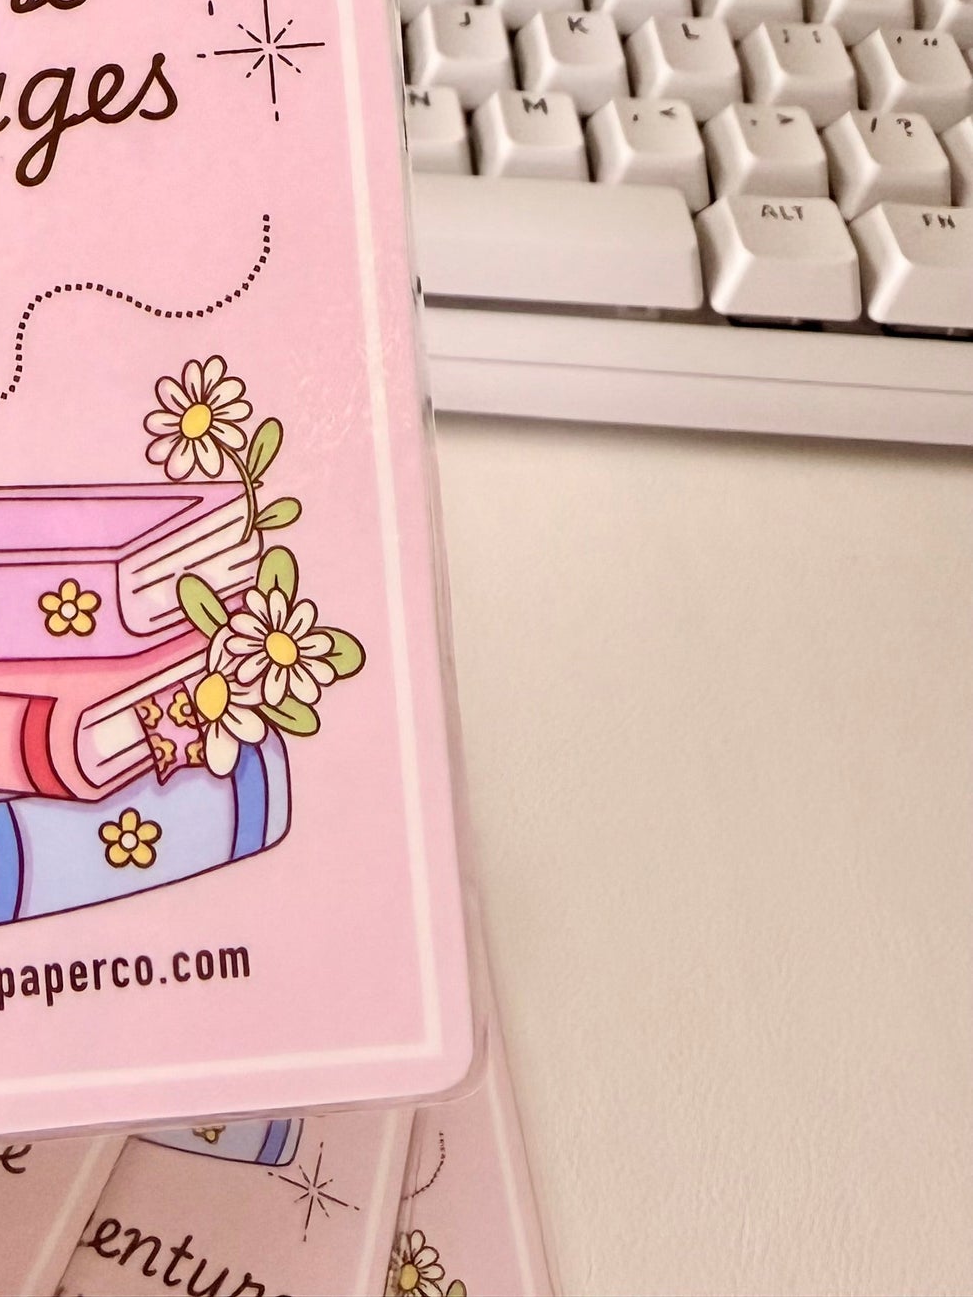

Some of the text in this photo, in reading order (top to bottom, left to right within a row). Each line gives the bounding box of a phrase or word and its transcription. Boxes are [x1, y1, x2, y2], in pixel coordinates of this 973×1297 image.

[459, 10, 471, 28] J
[566, 14, 589, 35] K
[681, 21, 700, 40] L
[760, 202, 805, 222] ALT
